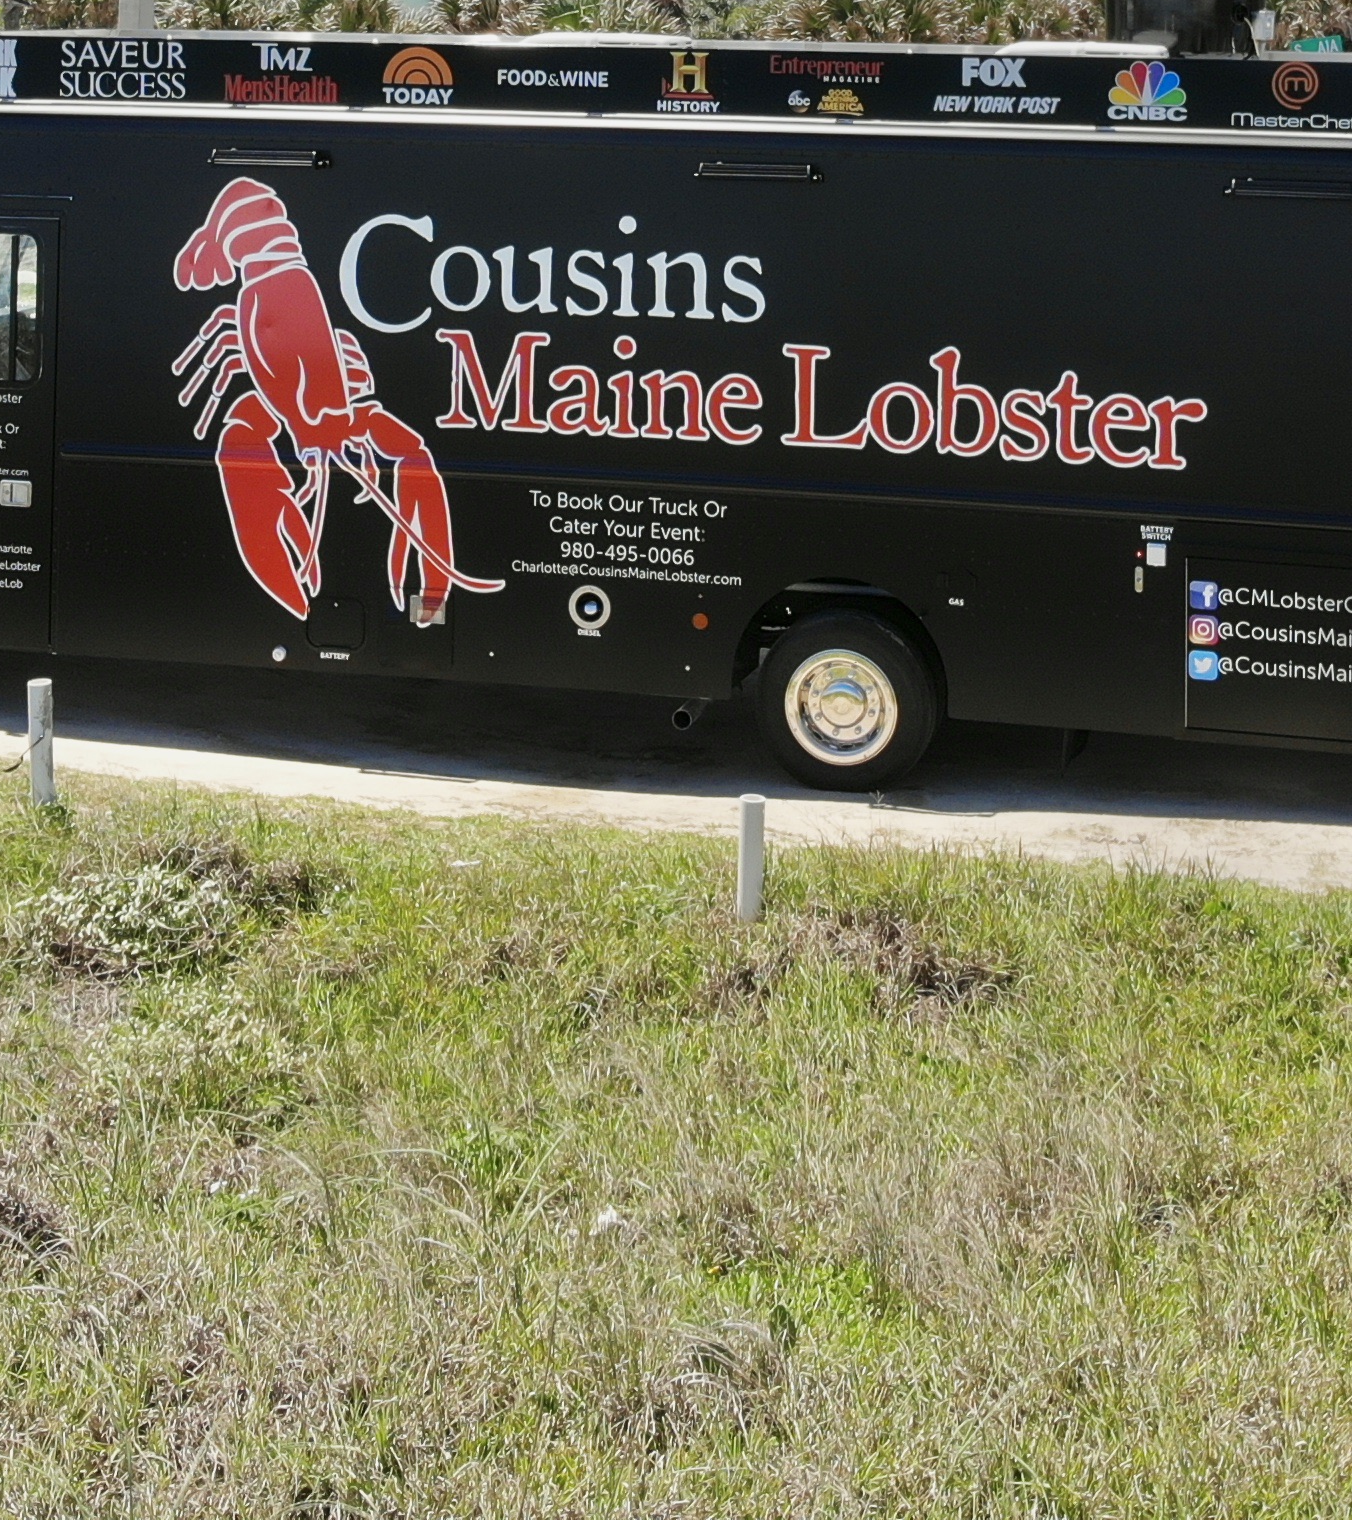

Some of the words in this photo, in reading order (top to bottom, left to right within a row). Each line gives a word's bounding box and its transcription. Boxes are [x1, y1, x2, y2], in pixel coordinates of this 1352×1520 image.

[60, 40, 186, 70] SAVEUR
[251, 42, 313, 72] TMZ
[769, 54, 885, 79] Entrepreneur
[59, 70, 186, 100] SUCCESS
[823, 75, 880, 84] MAGAZINE
[961, 57, 1027, 88] FOX
[382, 87, 454, 106] TODAY
[656, 99, 720, 113] HISTORY
[787, 92, 811, 107] abc
[816, 101, 865, 112] AMERICA
[933, 94, 973, 113] NEW
[973, 95, 1016, 114] YORK
[1017, 96, 1061, 115] POST
[1107, 104, 1188, 122] CNBC
[338, 213, 767, 335] Cousins
[434, 328, 764, 445] Maine
[780, 345, 1209, 472] Lobster
[5, 422, 20, 435] Or
[529, 490, 552, 507] To
[557, 492, 603, 511] Book
[608, 494, 644, 513] Our
[648, 496, 698, 517] Truck
[704, 500, 728, 519] Or
[549, 516, 598, 536] Cater
[603, 519, 645, 539] Your
[650, 522, 706, 543] Event:
[560, 541, 695, 566] 980-495-0066
[511, 560, 742, 587] Charlotte@CousinsMaineLobster.com
[948, 597, 964, 607] GAS
[319, 651, 350, 661] BATTERY
